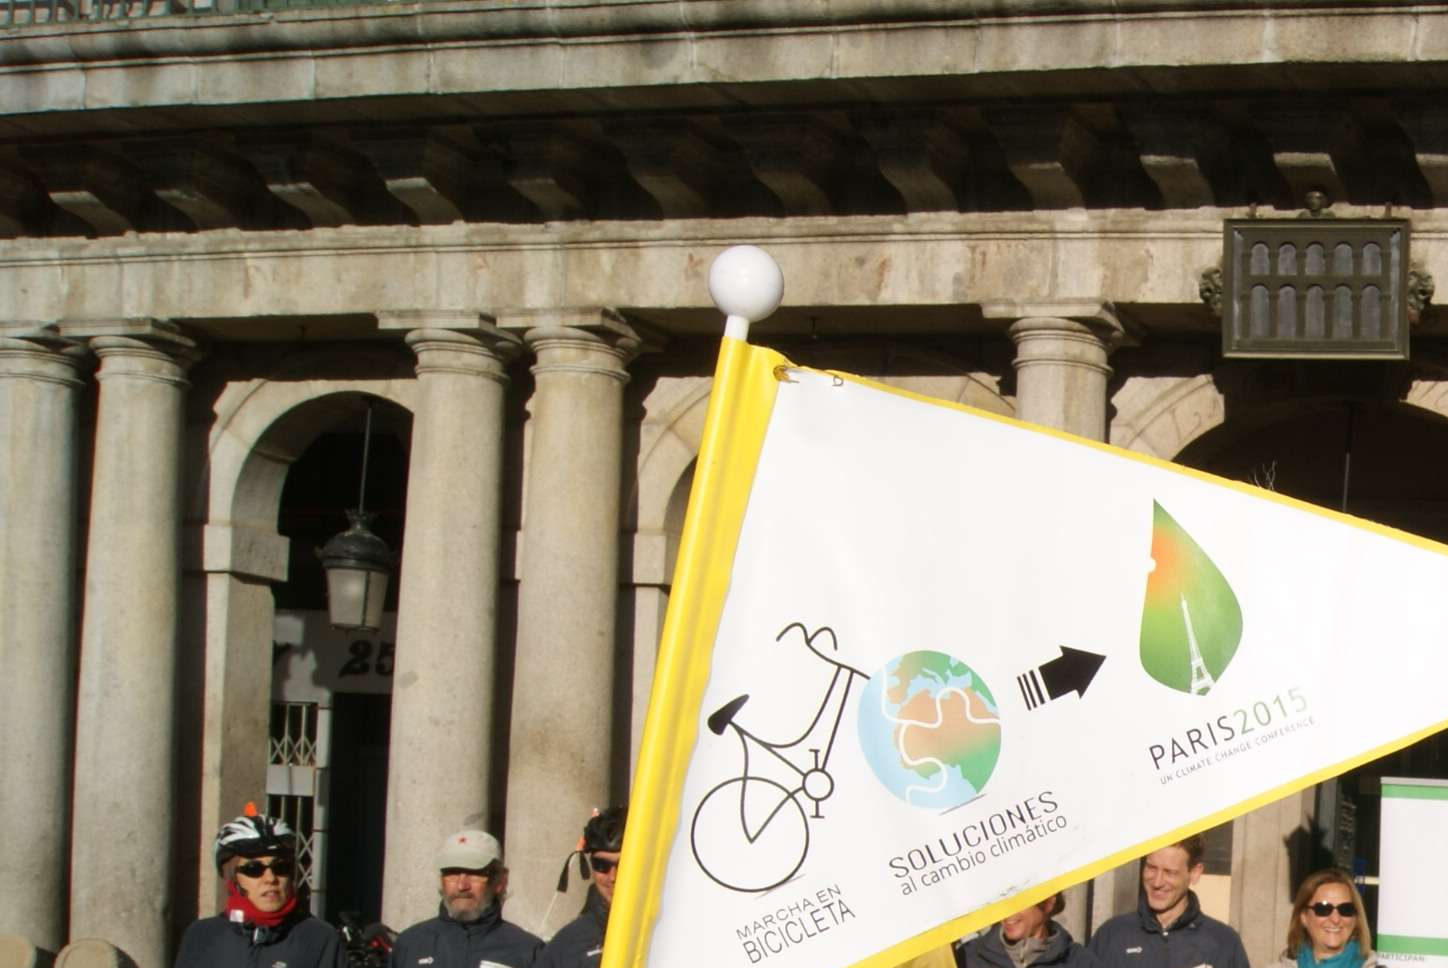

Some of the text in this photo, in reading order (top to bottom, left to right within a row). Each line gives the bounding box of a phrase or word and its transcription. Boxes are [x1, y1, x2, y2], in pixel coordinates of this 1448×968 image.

[1149, 686, 1308, 770] PARIS2015
[1160, 716, 1316, 786] UN CLIMATE CHANGE CONFERENCE
[888, 791, 1059, 880] SOLUCIONES
[901, 813, 1067, 896] al cambio climático
[736, 883, 842, 941] MARCHA EN
[742, 899, 856, 964] BICICLETA
